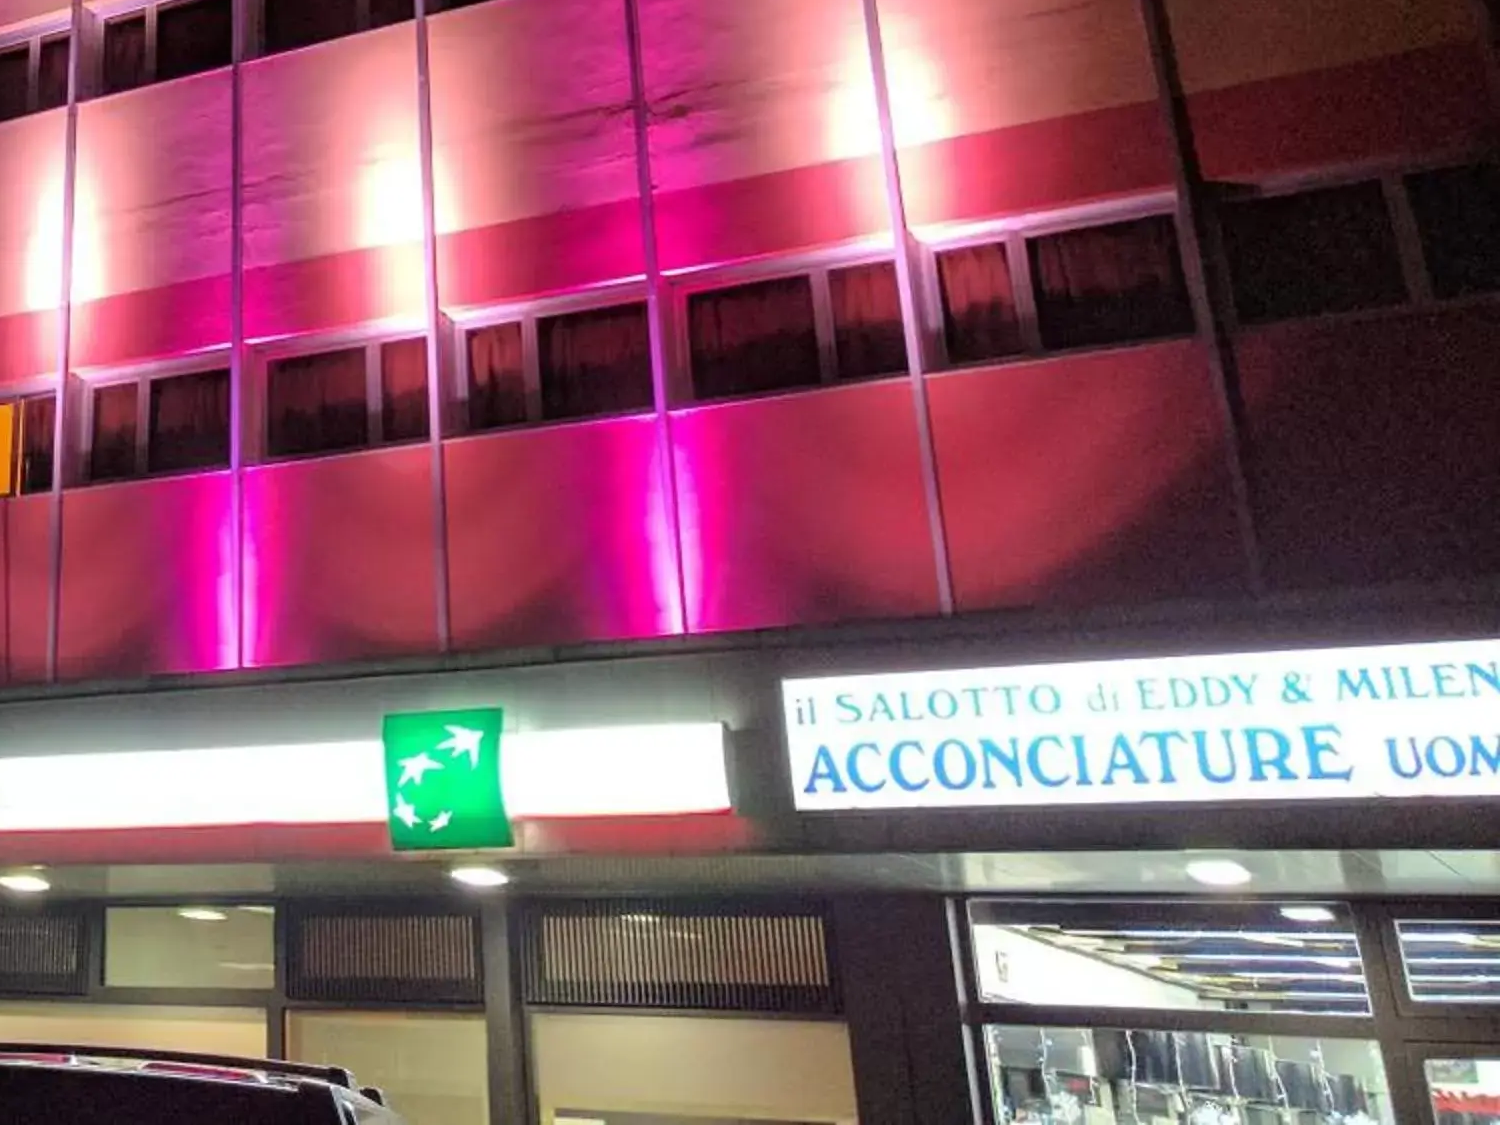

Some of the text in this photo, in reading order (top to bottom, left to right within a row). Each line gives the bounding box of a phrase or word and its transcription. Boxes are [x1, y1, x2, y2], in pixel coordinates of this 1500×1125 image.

[795, 661, 1500, 725] il SALOTTO di EDDY & MILEN
[803, 723, 1355, 794] ACCONCIATURE
